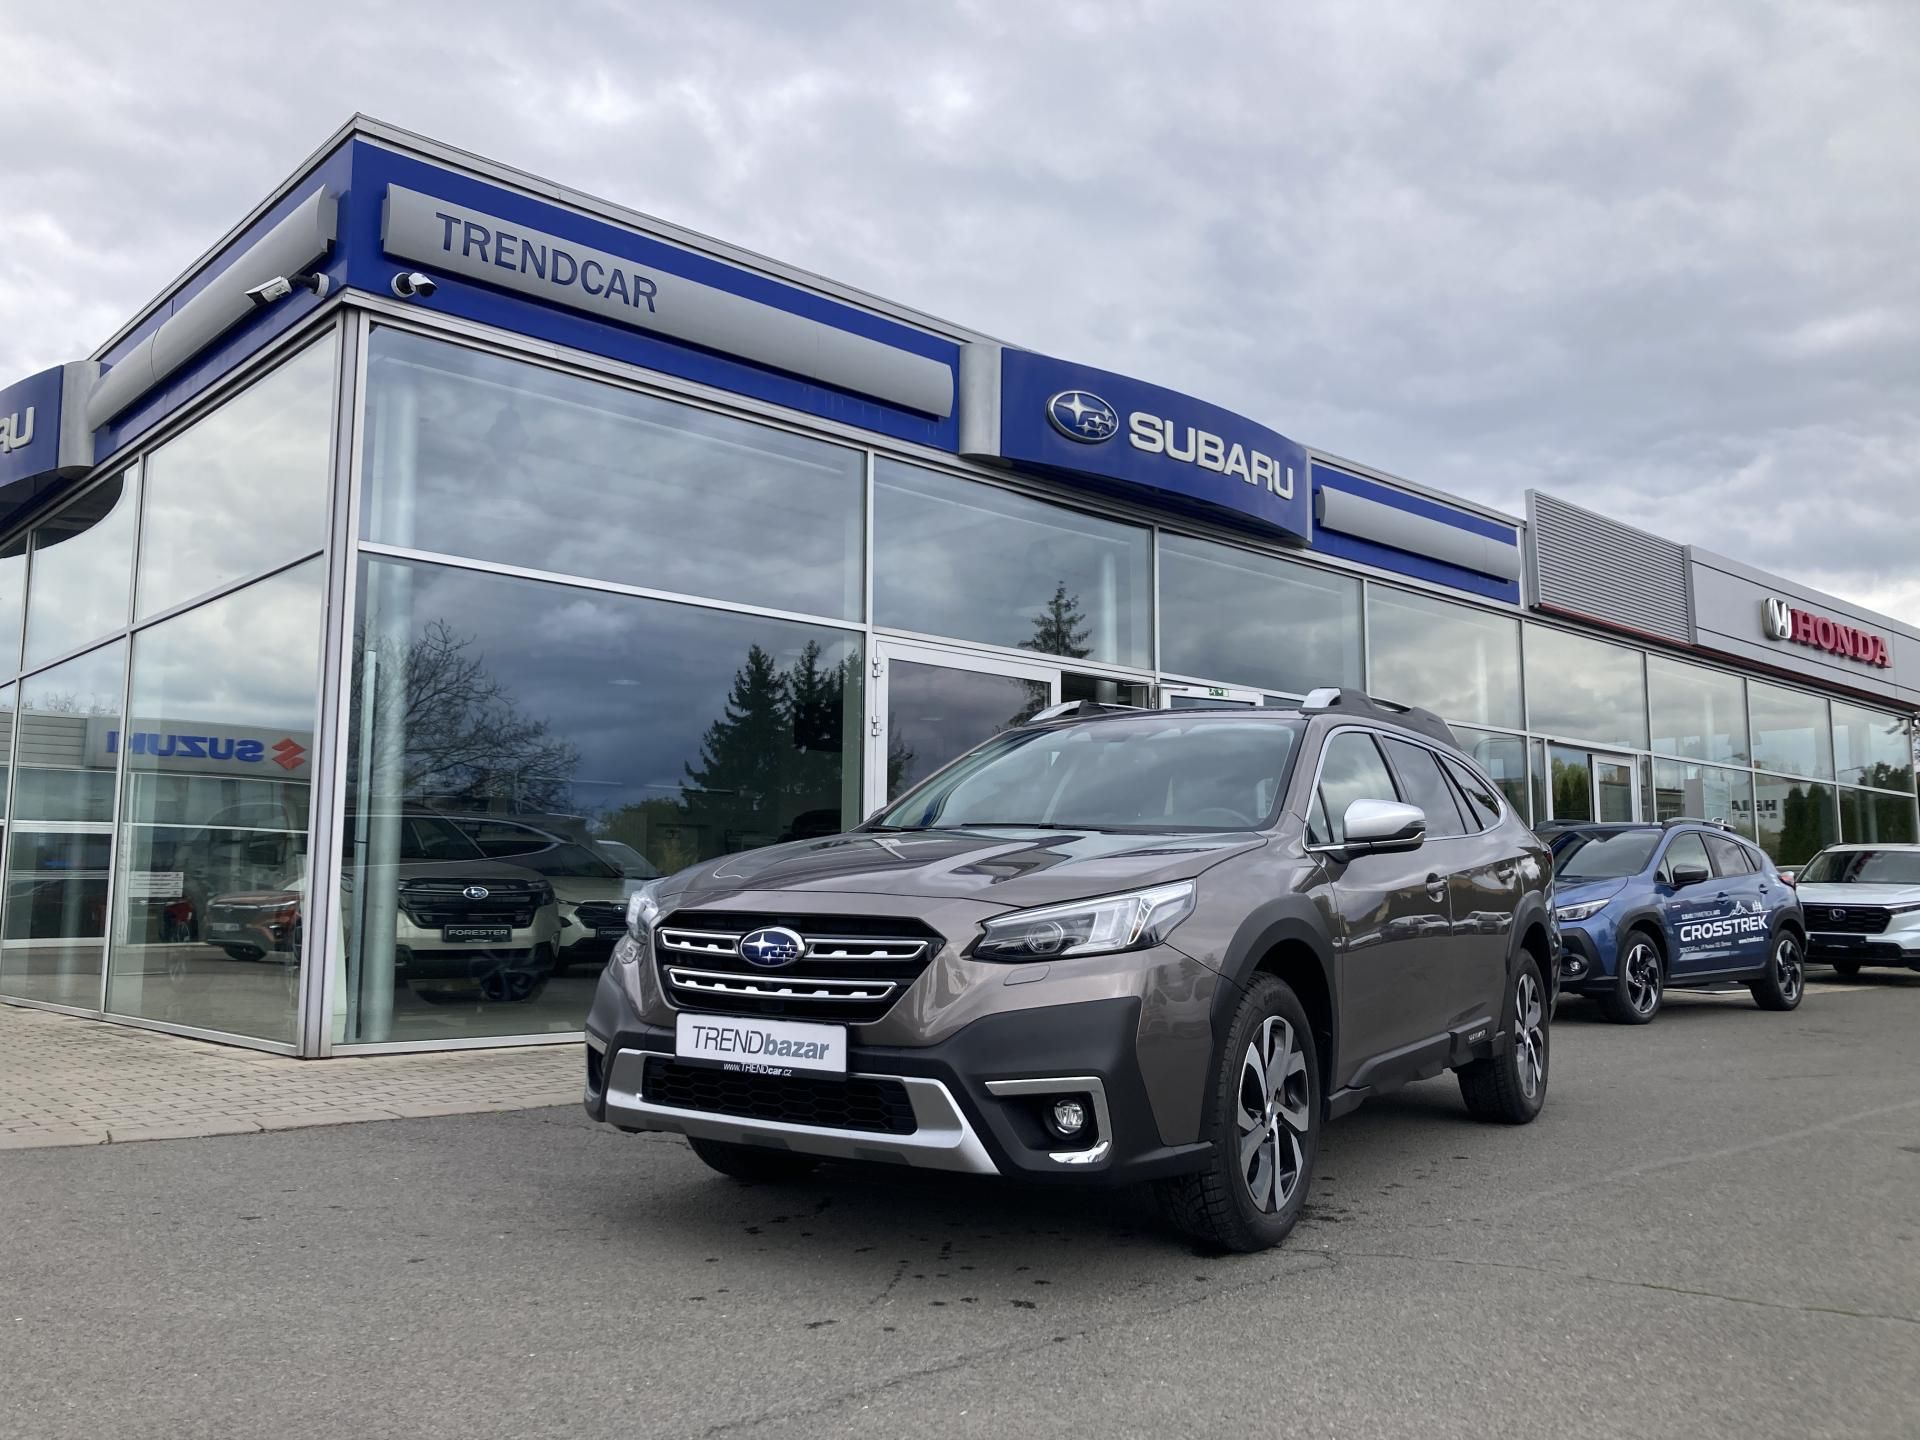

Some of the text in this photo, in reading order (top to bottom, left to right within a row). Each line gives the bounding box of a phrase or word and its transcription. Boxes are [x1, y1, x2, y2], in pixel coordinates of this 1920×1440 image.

[436, 212, 658, 313] TRENDCAR
[1129, 411, 1294, 500] SUBARU
[1789, 608, 1893, 668] HONDA
[448, 928, 508, 937] FORESTER
[1680, 915, 1769, 942] CROSSTREK
[692, 1025, 829, 1060] TRENDbazar
[723, 1062, 793, 1077] www.TRENDcar.cz
